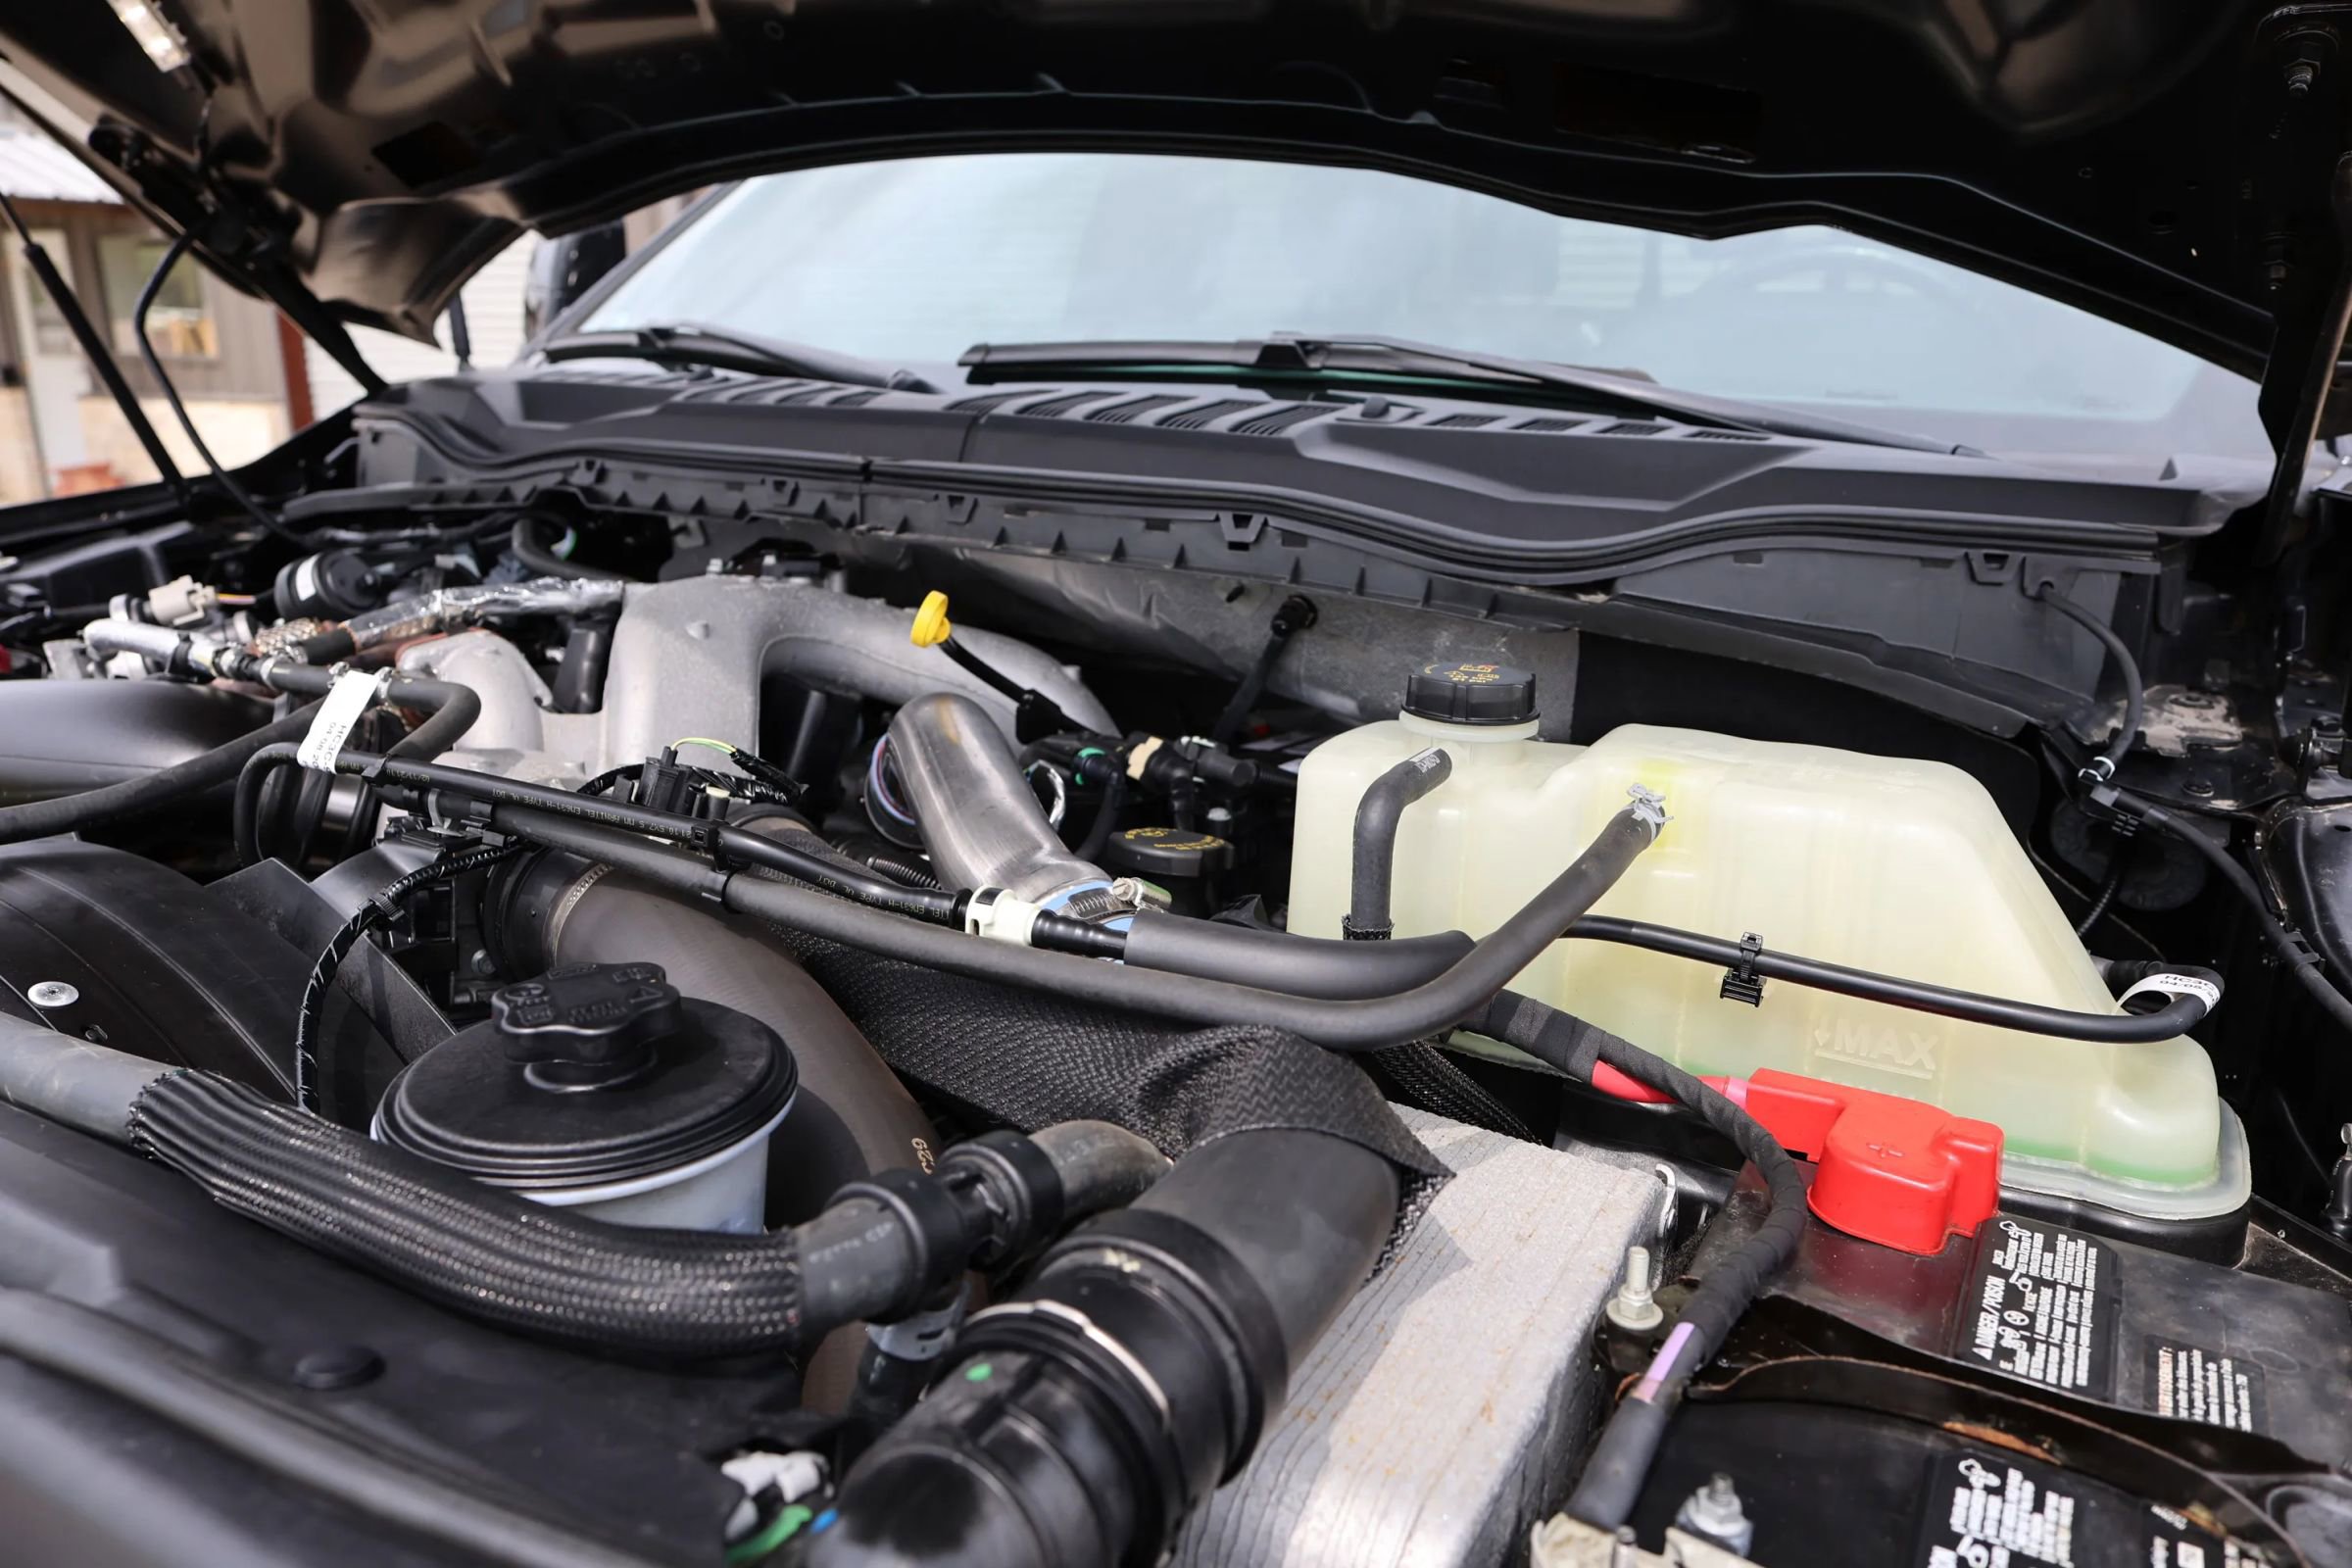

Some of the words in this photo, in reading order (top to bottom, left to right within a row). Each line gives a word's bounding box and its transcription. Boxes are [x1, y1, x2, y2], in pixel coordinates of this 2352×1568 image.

[523, 795, 542, 808] TYPE
[860, 893, 882, 906] TYPE
[1834, 1018, 1938, 1070] MAX
